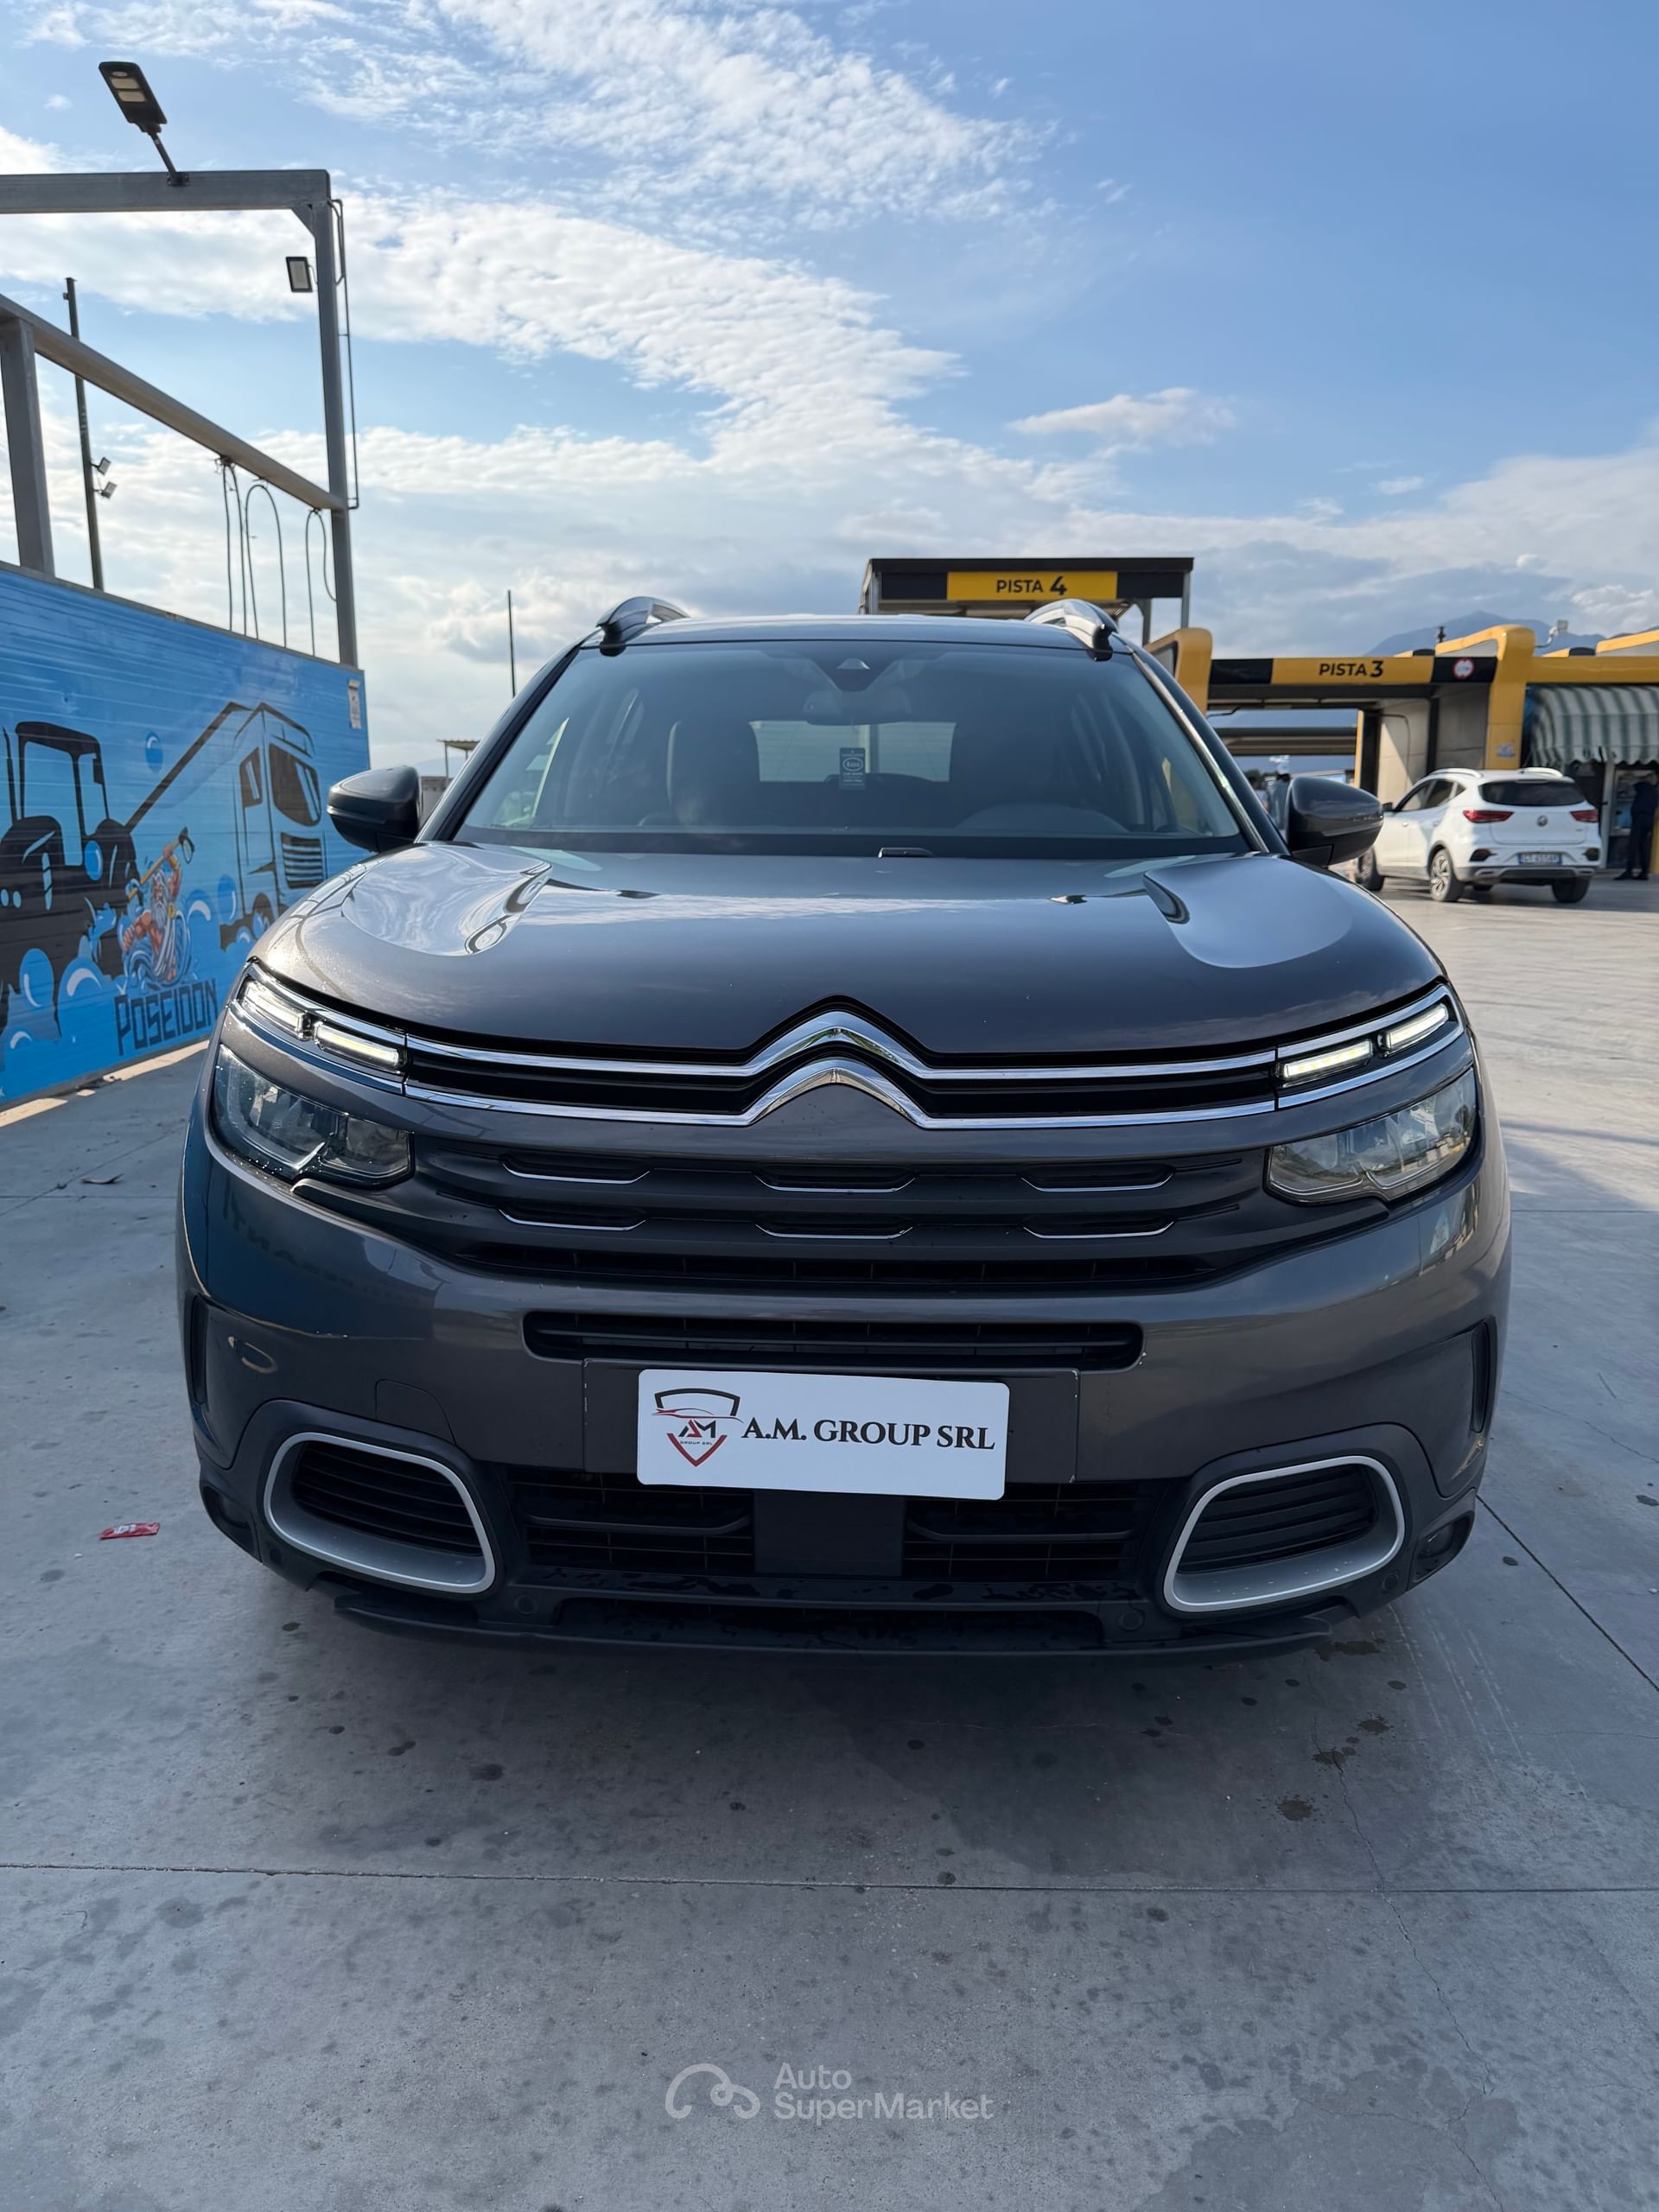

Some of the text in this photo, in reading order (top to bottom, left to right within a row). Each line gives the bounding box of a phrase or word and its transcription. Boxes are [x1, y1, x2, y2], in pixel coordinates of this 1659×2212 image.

[995, 575, 1068, 595] PISTA 4
[1319, 660, 1384, 677] PISTA 3
[114, 978, 219, 1056] POSEIDON
[741, 1417, 995, 1450] A.M. GROUP SRL
